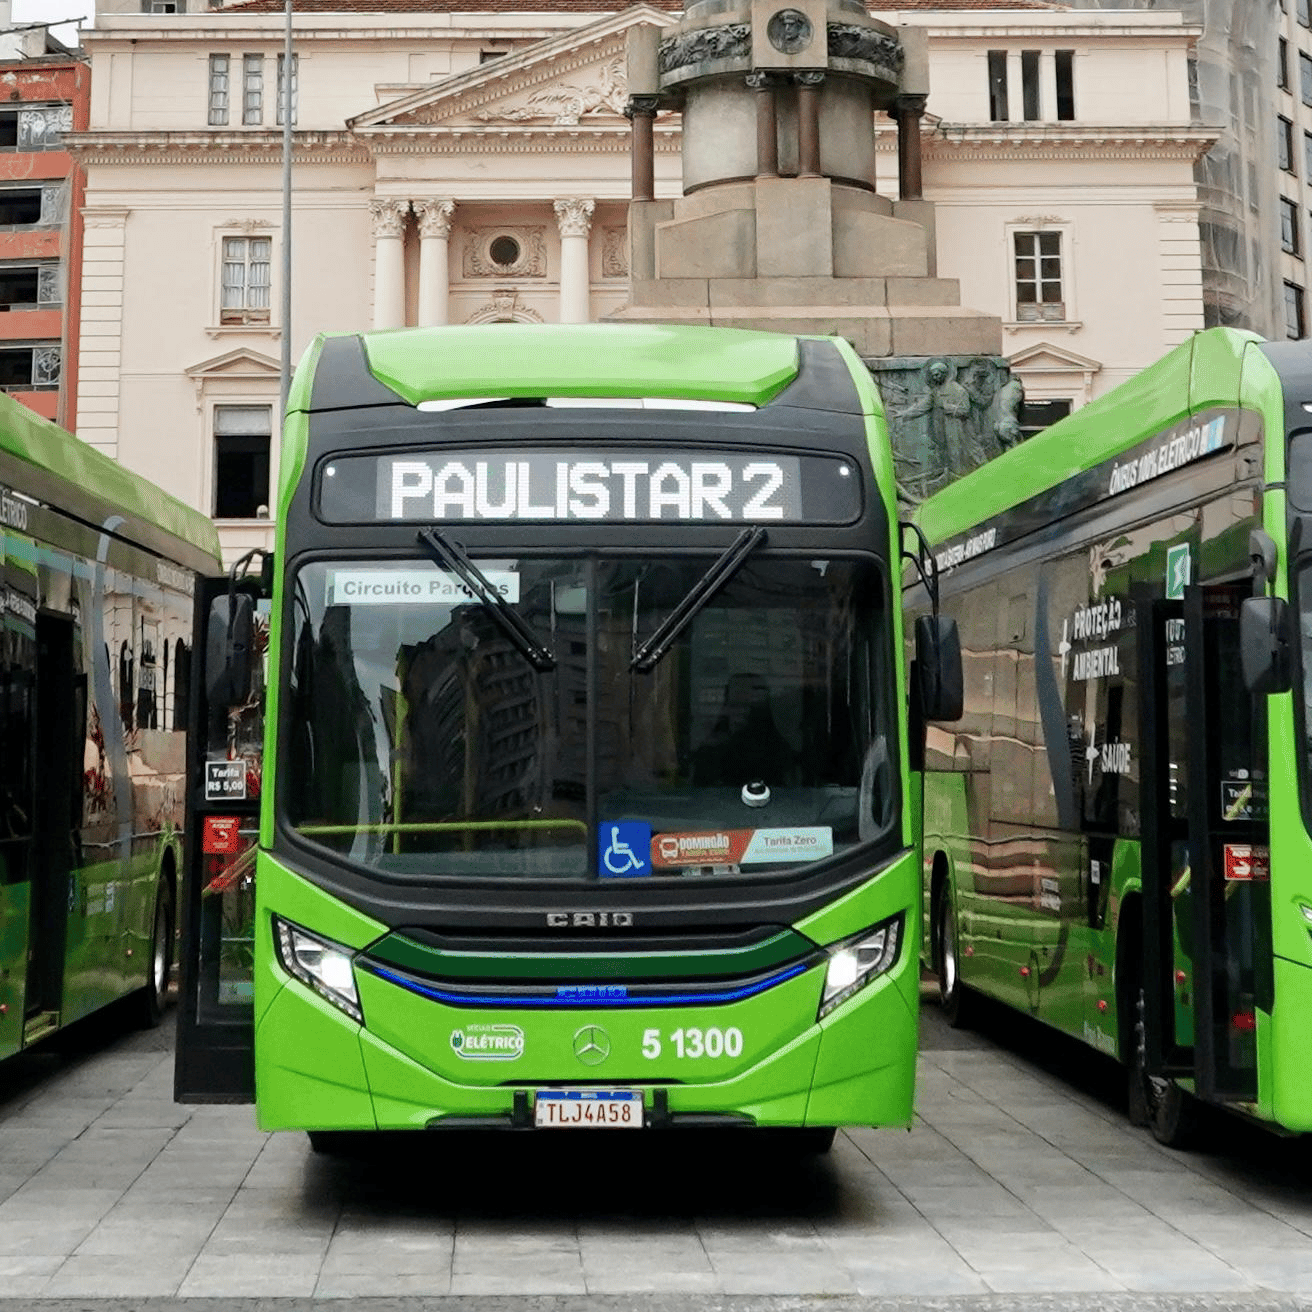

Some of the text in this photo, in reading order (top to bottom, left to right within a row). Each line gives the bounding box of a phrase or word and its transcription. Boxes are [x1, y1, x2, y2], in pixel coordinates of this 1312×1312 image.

[391, 461, 784, 519] PAULISTAR 2
[344, 581, 421, 595] Circuito
[1074, 596, 1122, 640] PROTEÇÃO
[1073, 646, 1120, 681] AMBIENTAL
[1101, 736, 1131, 773] SAÚDE
[212, 768, 240, 778] Tarifa
[223, 781, 244, 792] 5,00
[764, 836, 817, 846] Tarifa Zero
[547, 913, 634, 927] CAIO
[466, 1034, 524, 1049] ELÉTRICO
[641, 1026, 744, 1059] 5 1300
[546, 1102, 632, 1124] TLJ4A58
